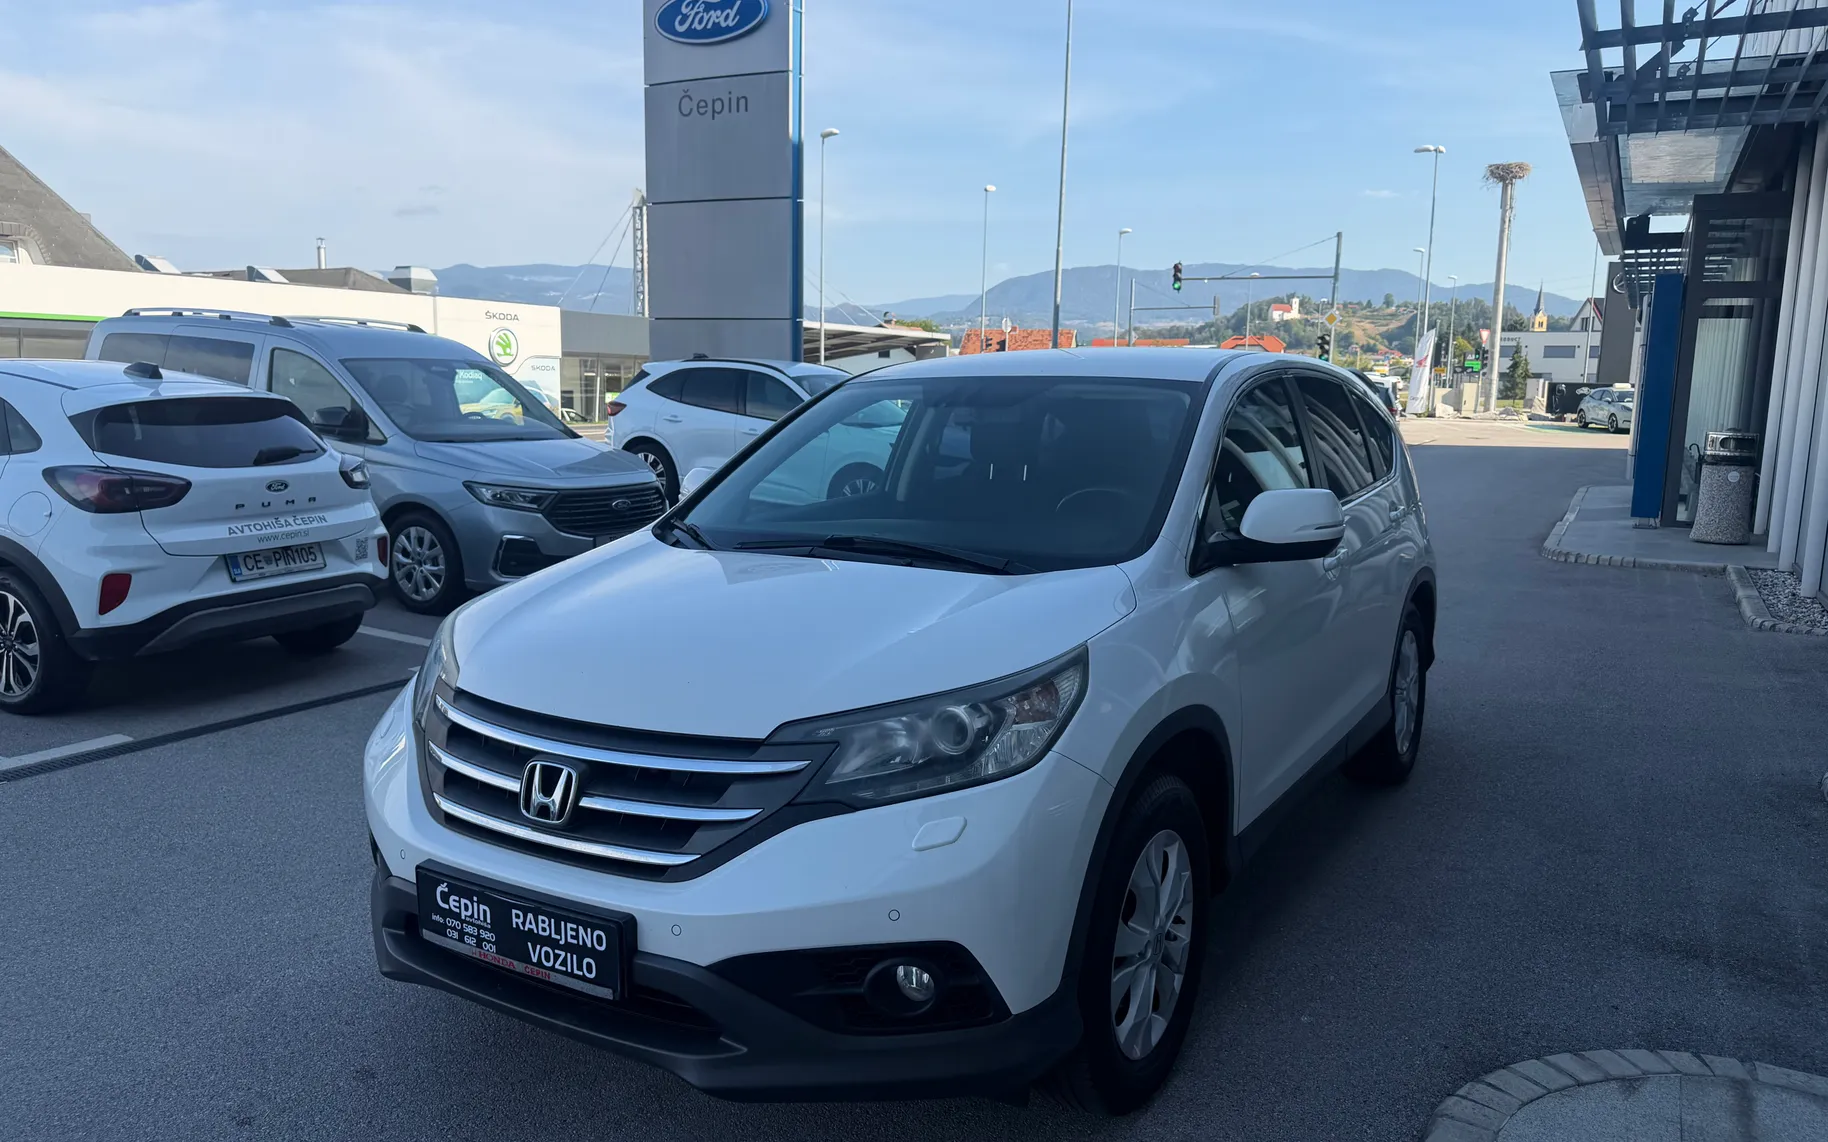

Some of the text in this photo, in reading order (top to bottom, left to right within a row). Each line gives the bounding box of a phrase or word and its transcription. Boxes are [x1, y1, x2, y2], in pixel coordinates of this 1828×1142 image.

[674, 0, 741, 32] Ford
[678, 89, 748, 120] Čepin
[485, 310, 519, 321] ŠKODA
[235, 497, 317, 510] PUMA
[228, 515, 328, 536] AVTOHIŠA ČEPIN
[257, 530, 310, 543] www.cepin.si
[243, 553, 265, 571] CE
[436, 882, 491, 924] Čepin
[446, 917, 461, 929] 070
[463, 923, 478, 936] 583
[480, 929, 496, 942] 920
[446, 928, 496, 953] 031 612 001
[511, 909, 607, 951] RABLJENO
[478, 950, 516, 969] HONDA
[527, 942, 597, 979] VOZILO
